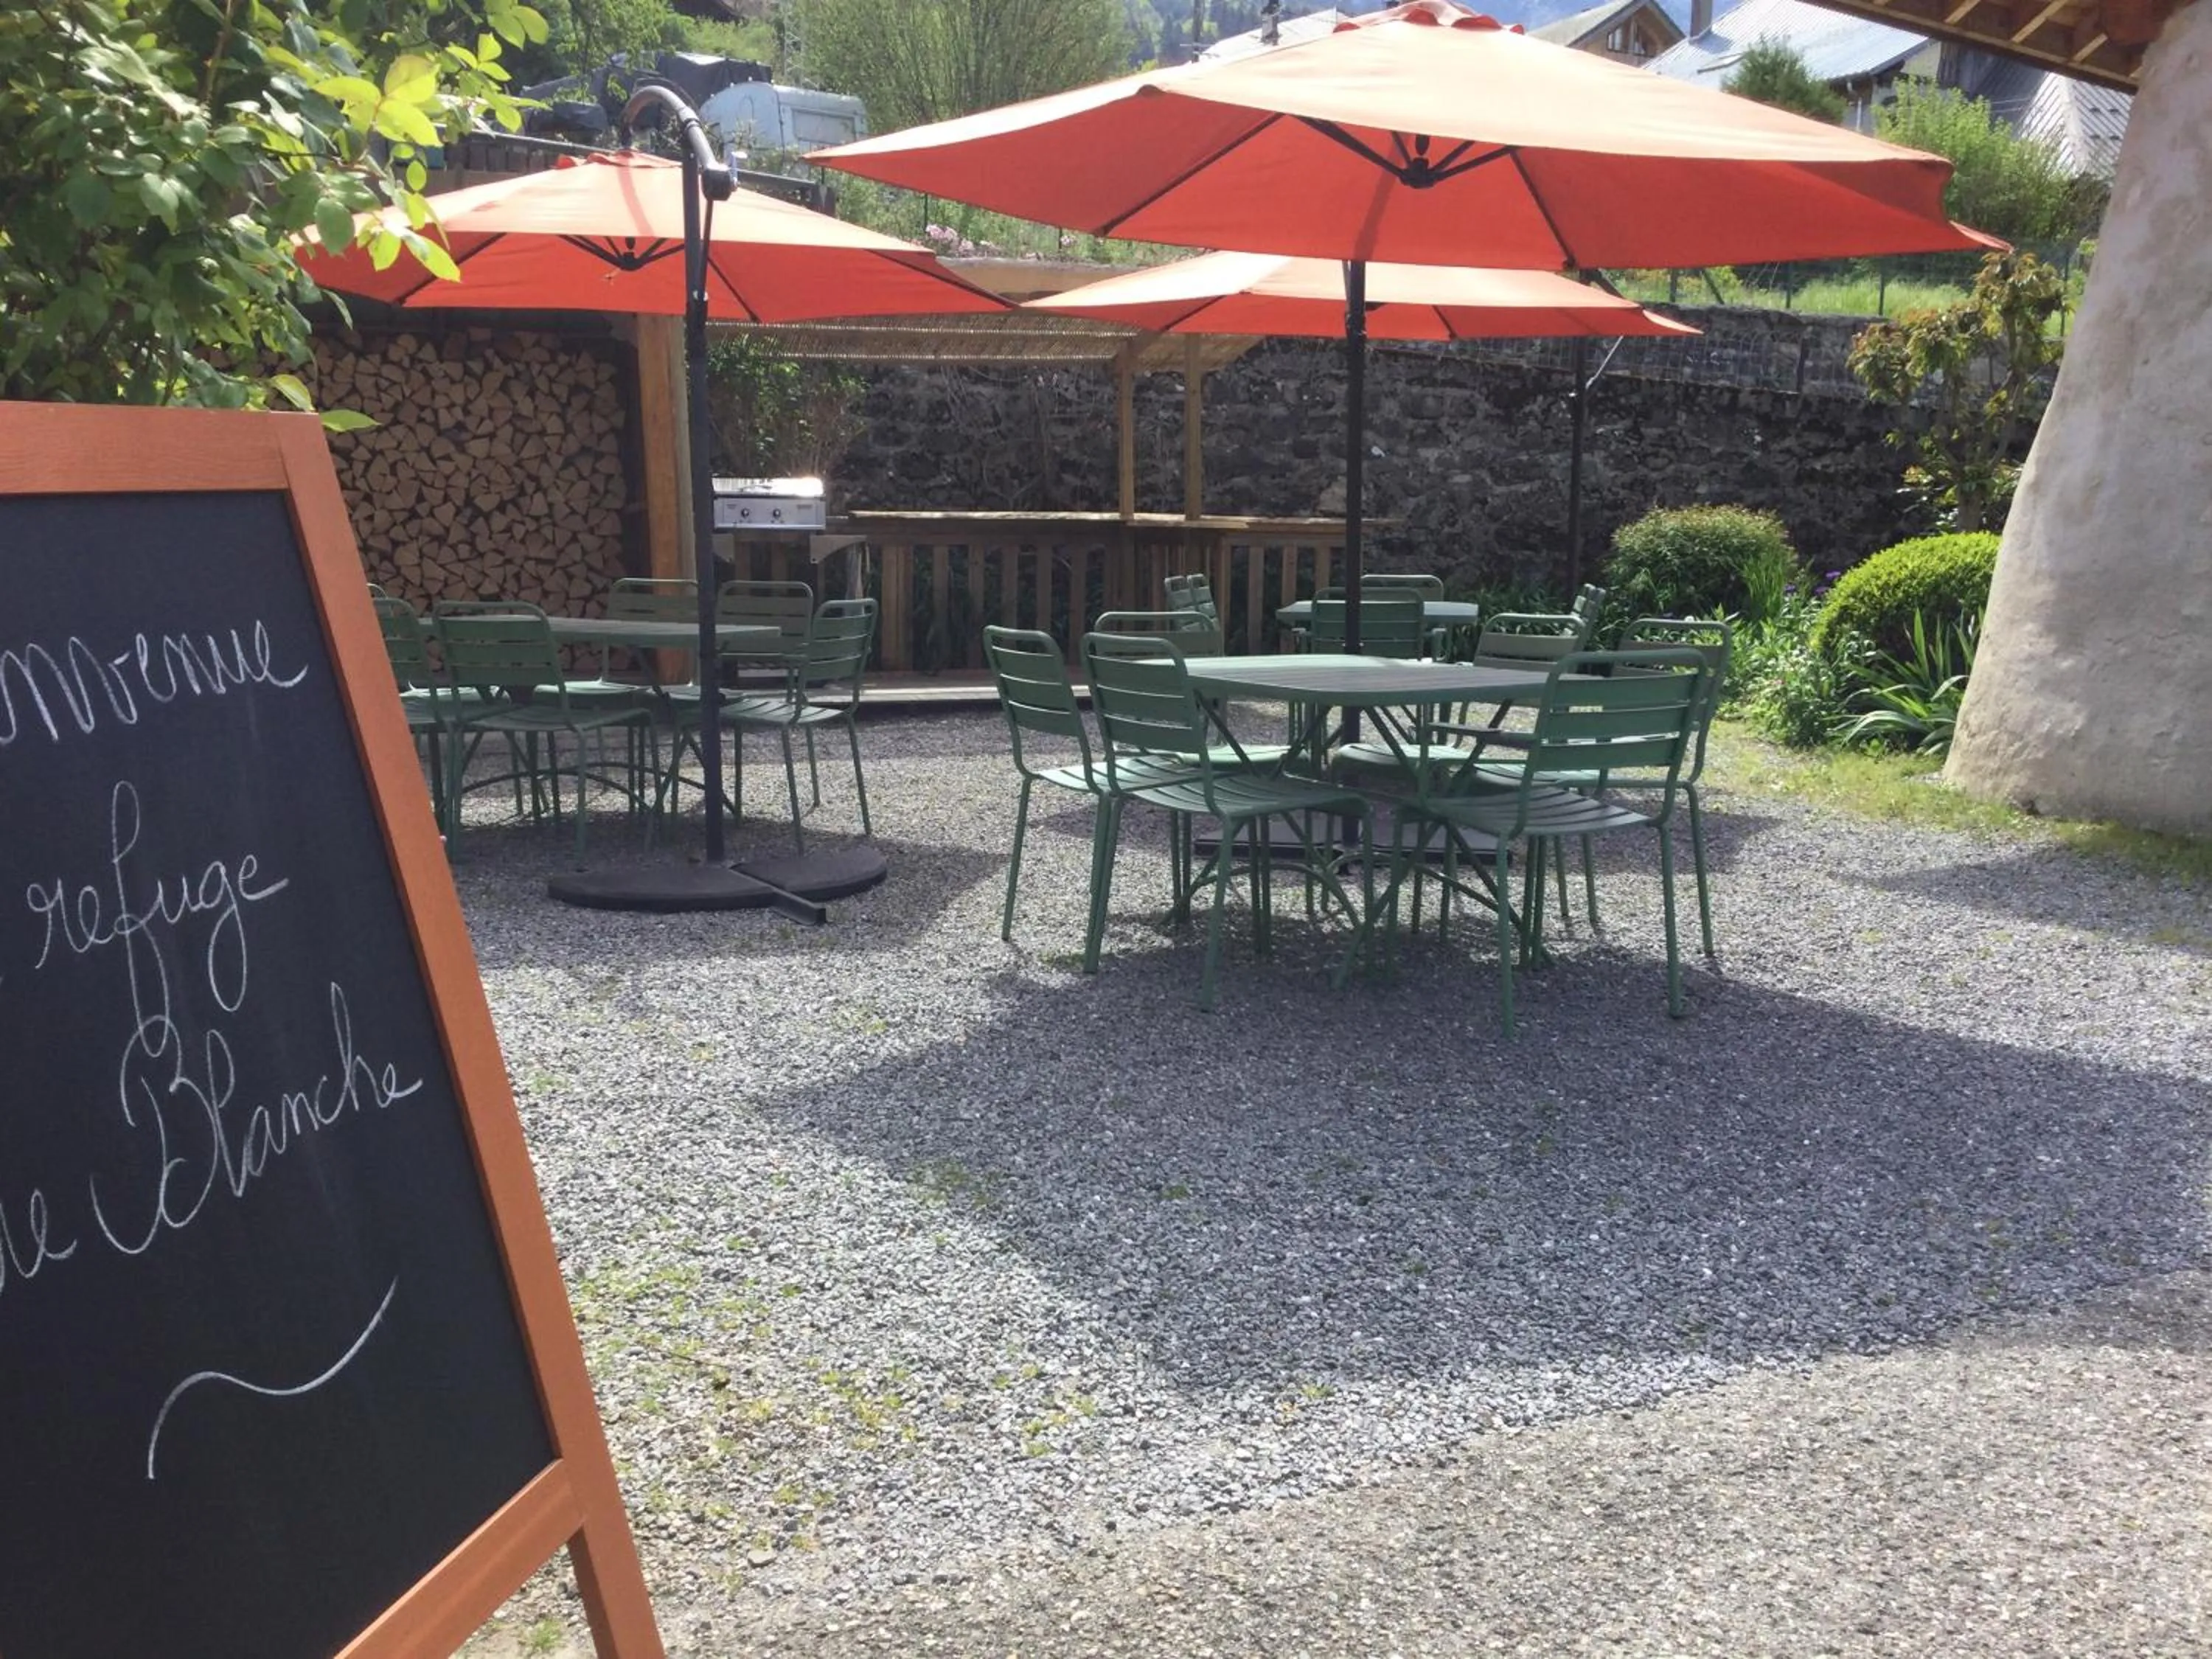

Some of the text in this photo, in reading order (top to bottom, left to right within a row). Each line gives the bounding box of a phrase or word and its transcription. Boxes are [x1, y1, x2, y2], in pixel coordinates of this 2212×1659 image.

[0, 619, 308, 745] nvenue
[27, 780, 289, 1057] refuge
[90, 981, 423, 1255] Blanche
